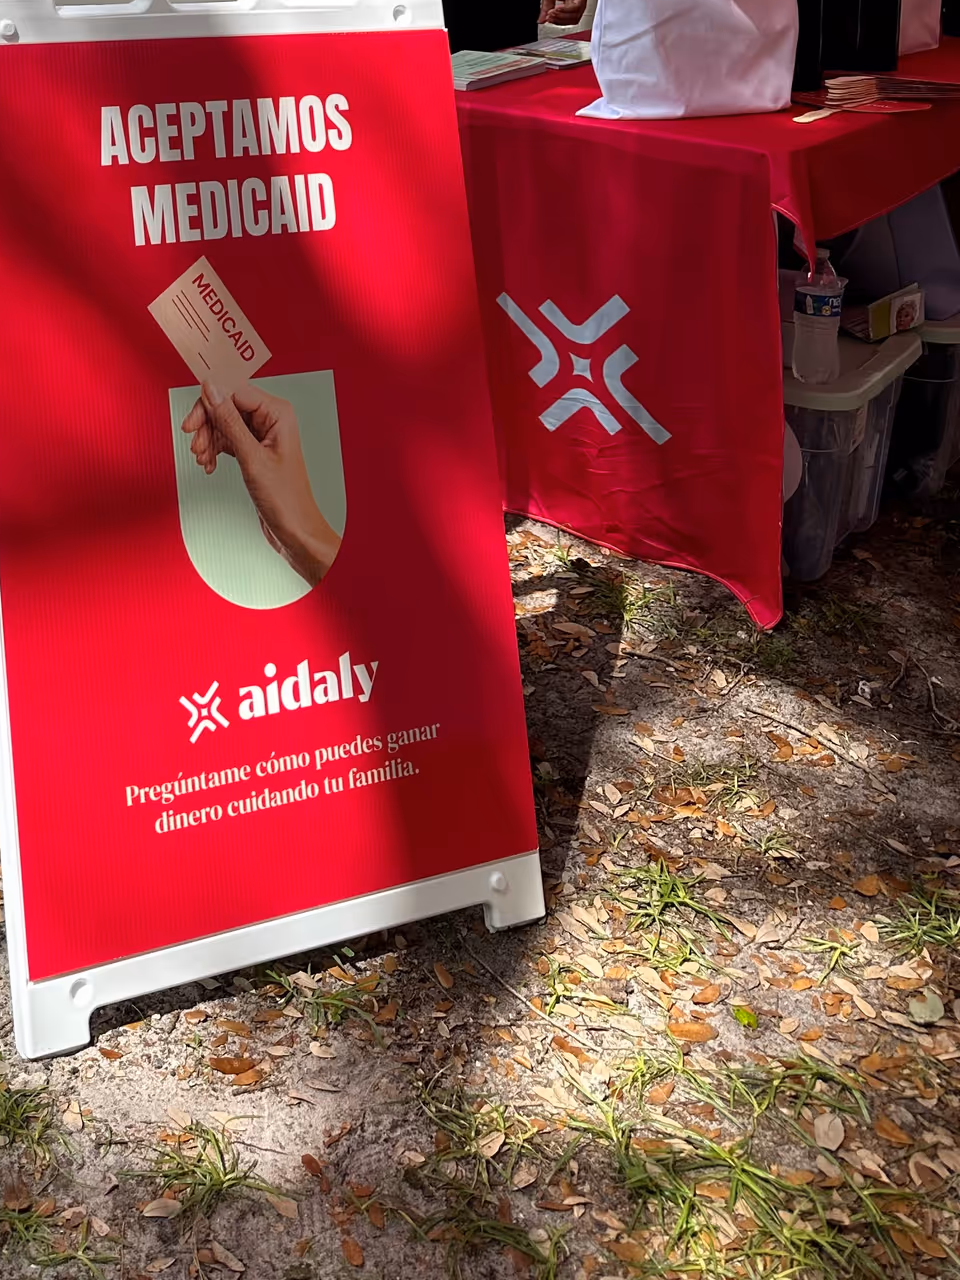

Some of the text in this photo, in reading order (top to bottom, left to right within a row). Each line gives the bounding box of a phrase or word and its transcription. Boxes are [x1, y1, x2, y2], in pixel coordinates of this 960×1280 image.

[100, 92, 353, 166] ACEPTAMOS
[130, 172, 337, 247] MEDICAID
[191, 272, 256, 363] MEDICAID
[238, 651, 379, 720] aidaly
[125, 722, 441, 807] Pregúntame cómo puedes ganar
[154, 758, 420, 834] dinero cuidando tu familia.
